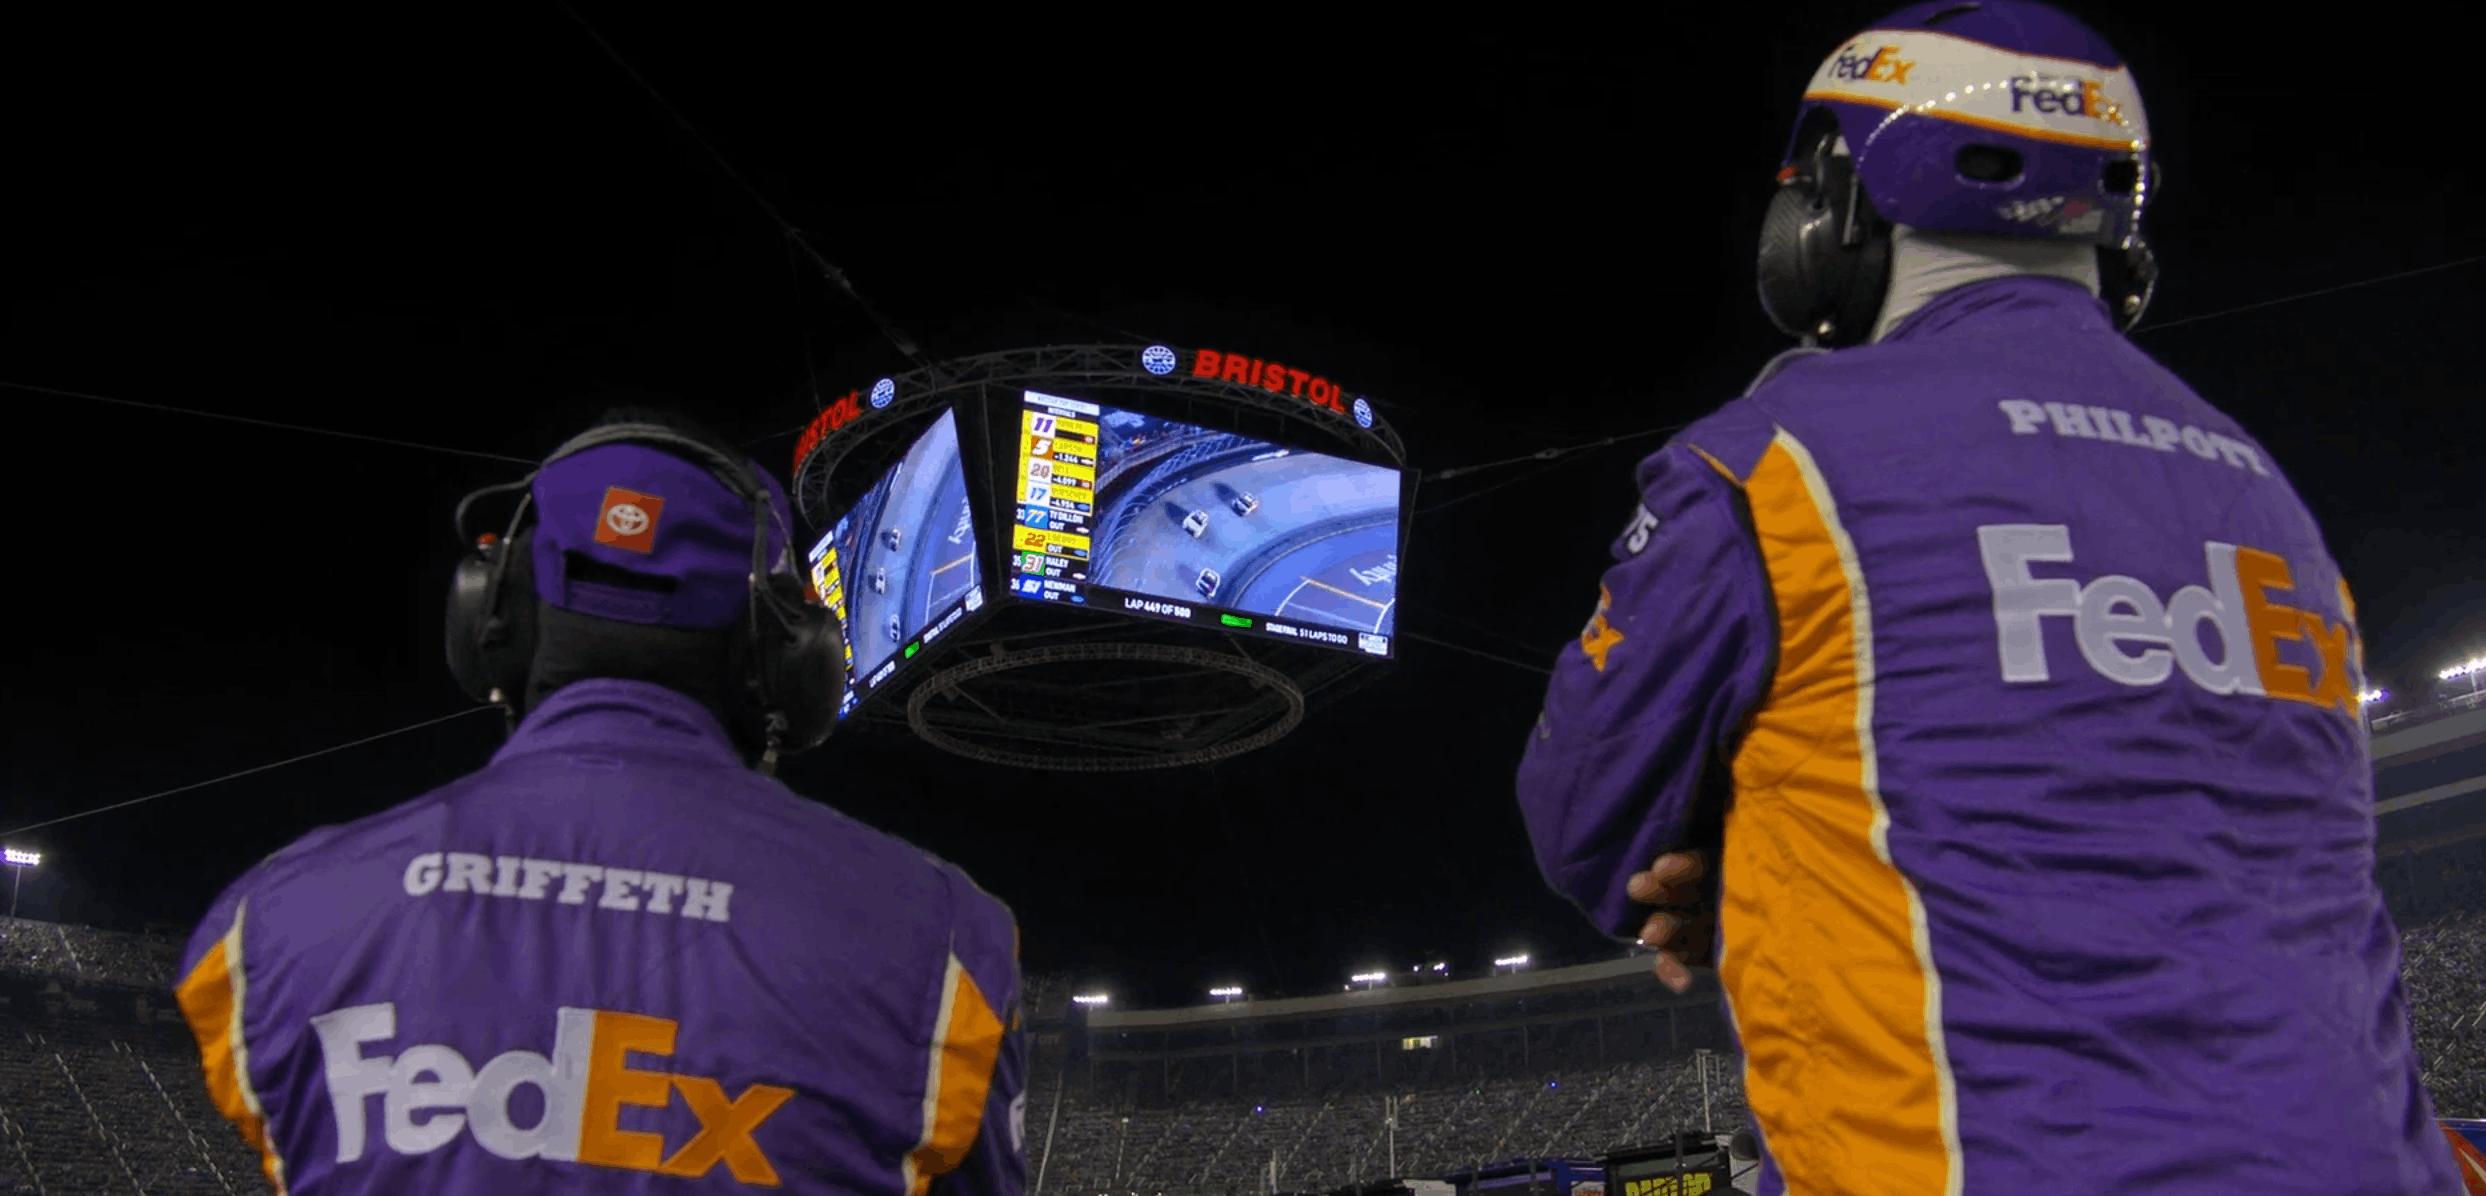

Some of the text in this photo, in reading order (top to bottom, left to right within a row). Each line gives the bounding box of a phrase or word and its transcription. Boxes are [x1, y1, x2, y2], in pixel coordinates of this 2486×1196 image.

[1827, 43, 1917, 86] FedEx
[2010, 74, 2128, 127] FedEx
[1193, 349, 1346, 416] BRISTOL
[1034, 417, 1053, 433] 11
[1999, 399, 2270, 477] PHILPOTT
[1032, 439, 1052, 456] 5
[1030, 463, 1050, 479] 20
[1030, 487, 1047, 501] 17
[1025, 509, 1047, 523] 77
[1049, 521, 1065, 531] OUT
[1025, 532, 1046, 547] 22
[1047, 544, 1062, 553] OUT
[1045, 567, 1061, 577] OUT
[1044, 590, 1060, 600] OUT
[1125, 597, 1192, 618] LAP 449 OF 500
[1977, 523, 2359, 721] FedEx
[1309, 630, 1327, 641] LAPS
[1328, 633, 1337, 642] TO
[1337, 635, 1348, 645] GO
[403, 851, 735, 923] GRIFFETH
[310, 1002, 796, 1188] FedEx
